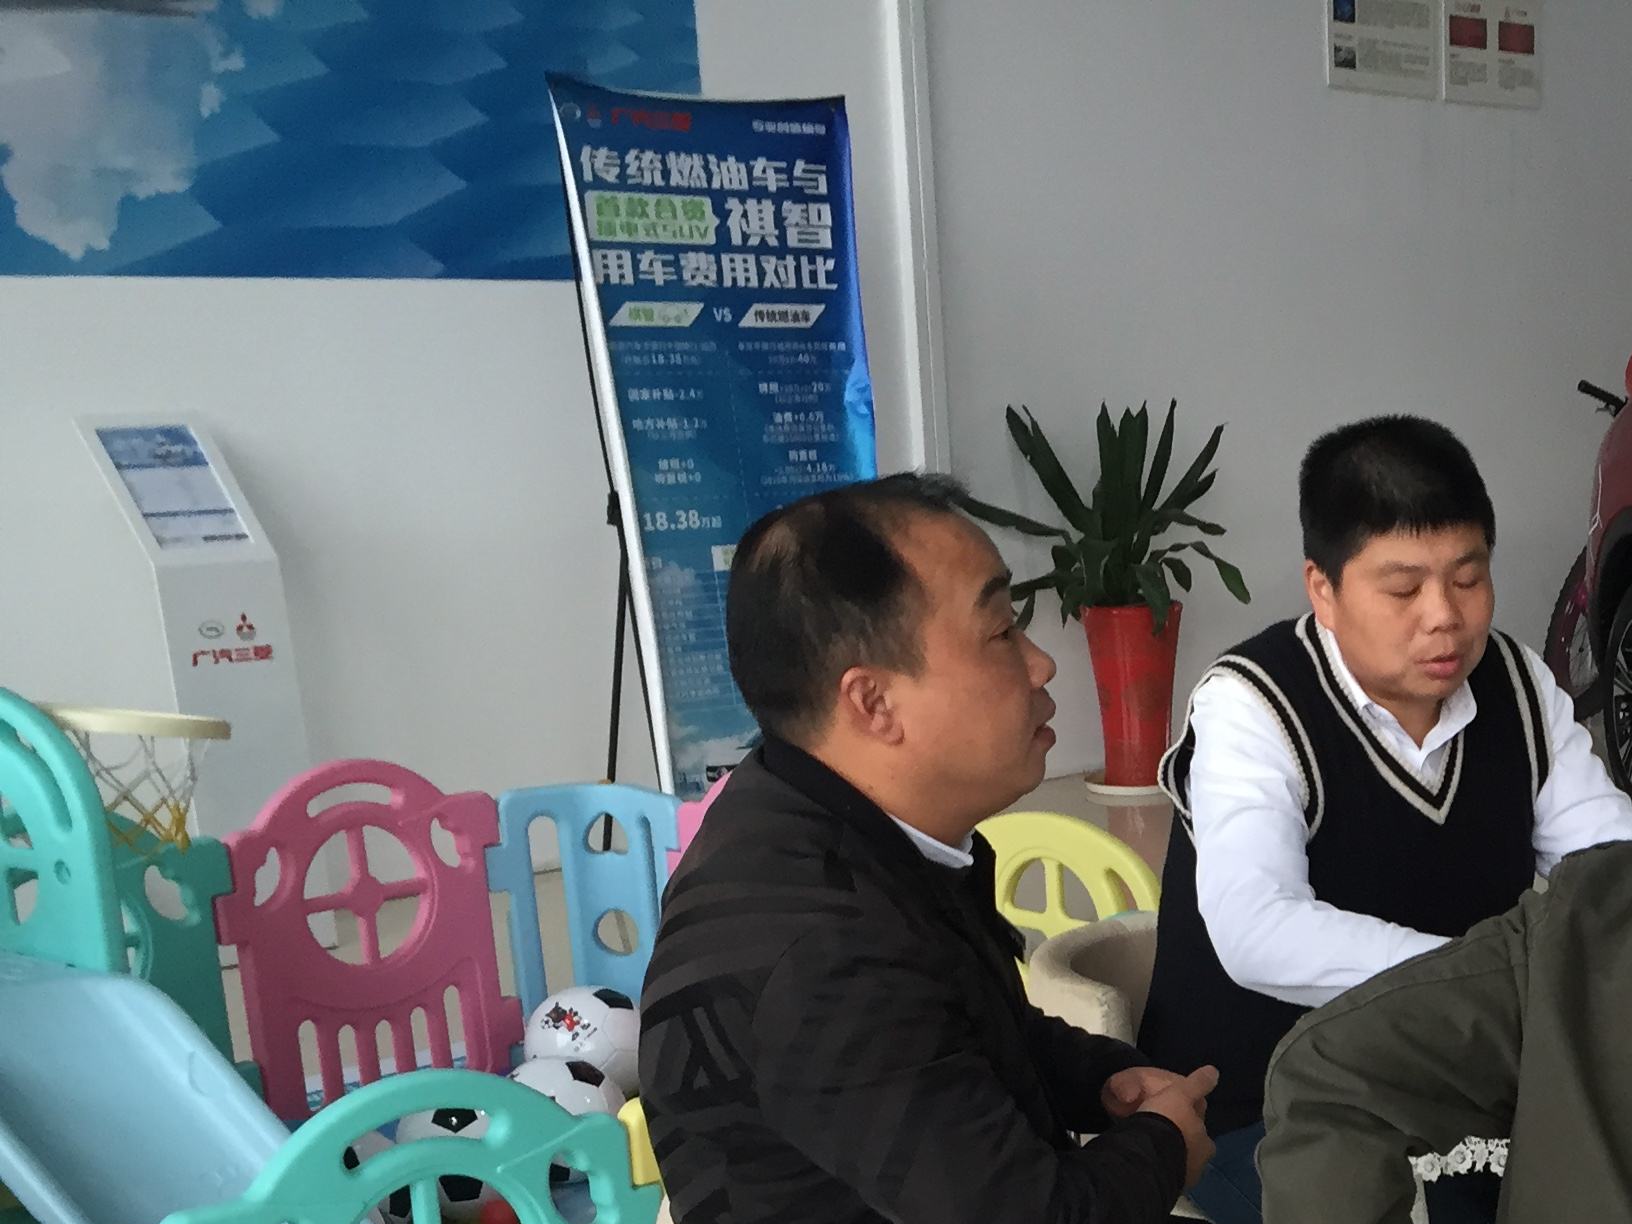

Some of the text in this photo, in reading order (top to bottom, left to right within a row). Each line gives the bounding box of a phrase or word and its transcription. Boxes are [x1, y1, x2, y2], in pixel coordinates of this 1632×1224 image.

[580, 145, 828, 195] 传统燃油车与
[725, 198, 833, 249] 祺智
[592, 249, 839, 290] 用车费用对比
[713, 308, 732, 322] VS
